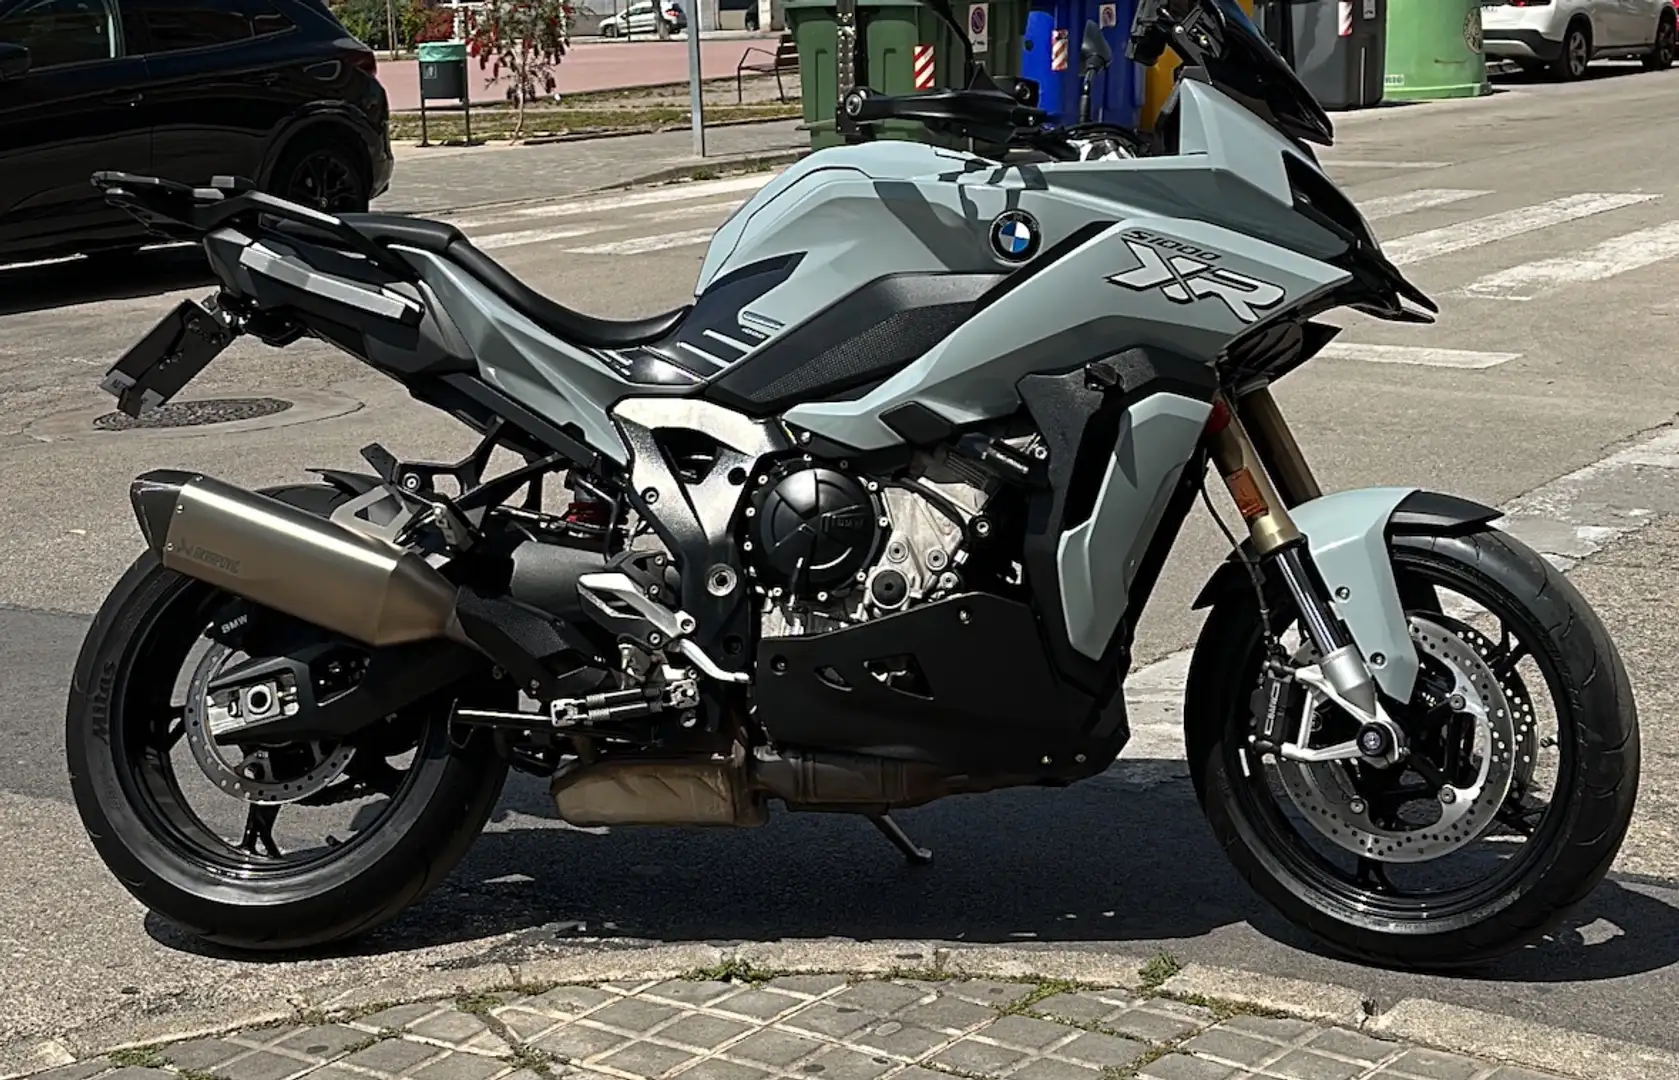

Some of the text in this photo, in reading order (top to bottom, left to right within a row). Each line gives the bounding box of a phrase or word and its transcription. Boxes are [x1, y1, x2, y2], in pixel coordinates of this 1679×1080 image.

[1103, 237, 1287, 325] XR
[220, 613, 248, 634] BMW
[91, 660, 117, 747] Mitas
